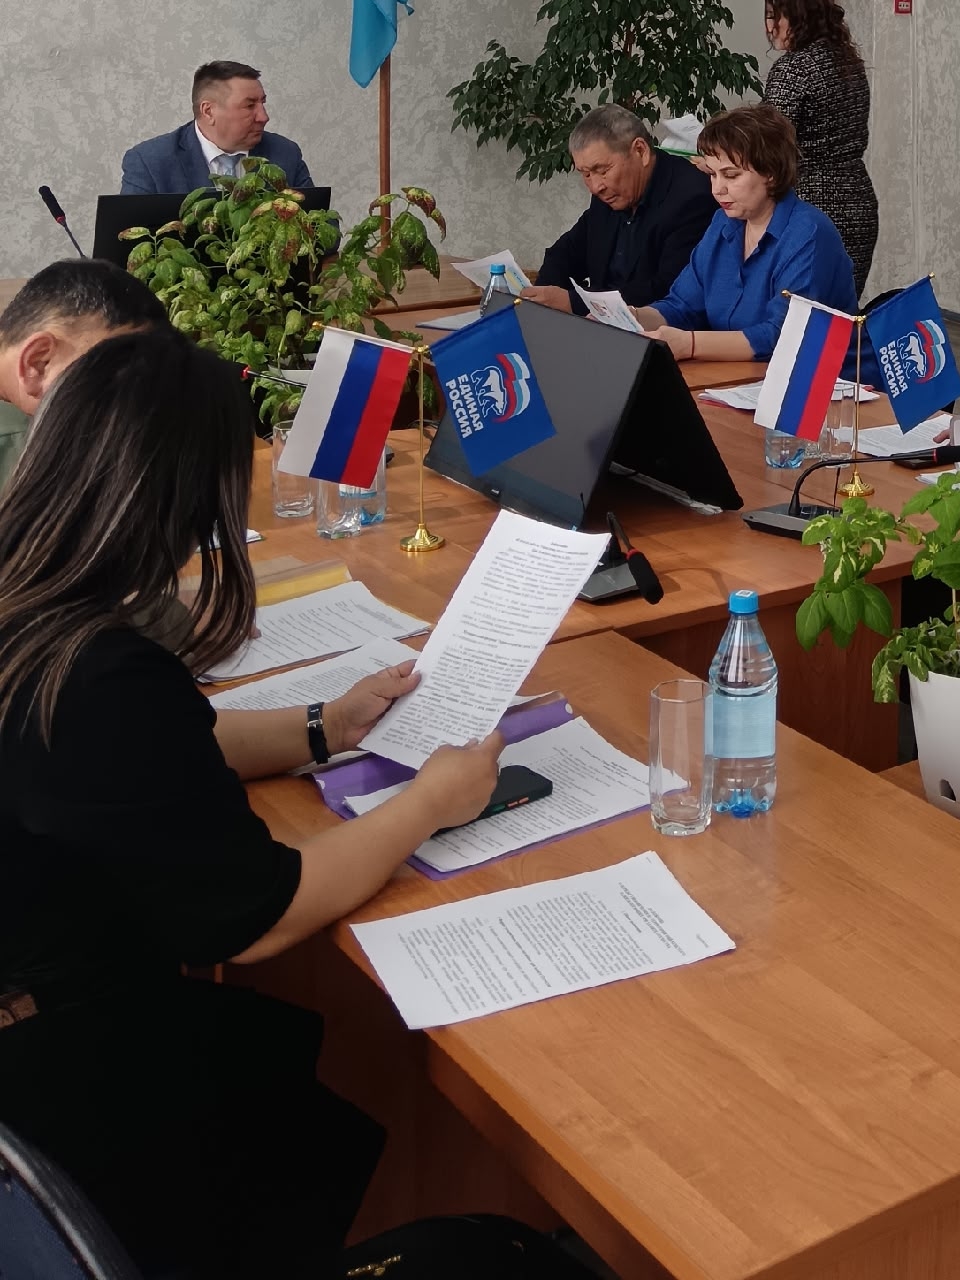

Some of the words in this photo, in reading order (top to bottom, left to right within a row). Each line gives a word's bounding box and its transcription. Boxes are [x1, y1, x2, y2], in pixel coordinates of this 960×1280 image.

[879, 346, 900, 399] РОССИЯ
[887, 340, 909, 393] ЕДИНАЯ
[445, 379, 473, 439] РОССИЯ
[457, 373, 485, 432] ЕДИНАЯ
